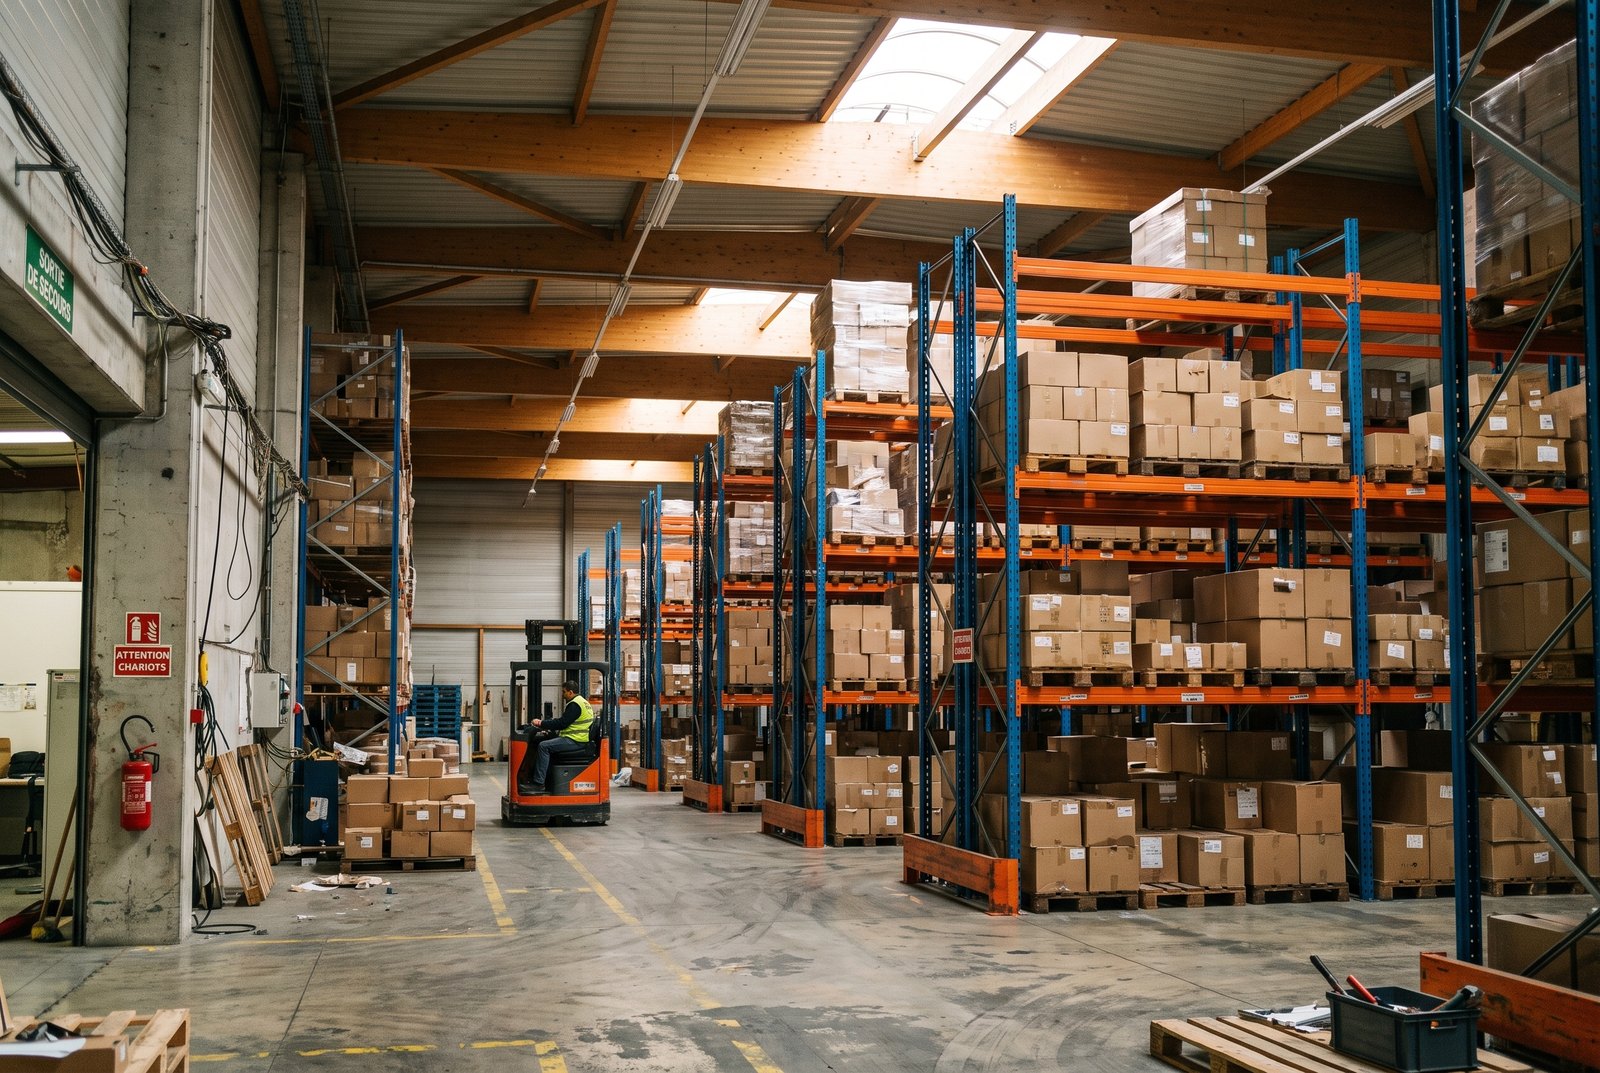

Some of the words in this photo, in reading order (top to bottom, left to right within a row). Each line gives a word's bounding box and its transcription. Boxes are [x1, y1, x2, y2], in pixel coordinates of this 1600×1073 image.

[39, 247, 65, 290] SORTIE
[27, 262, 38, 290] DE
[39, 275, 71, 323] SECOURS
[116, 651, 170, 660] ATTENTION
[118, 663, 167, 672] CHARIOTS
